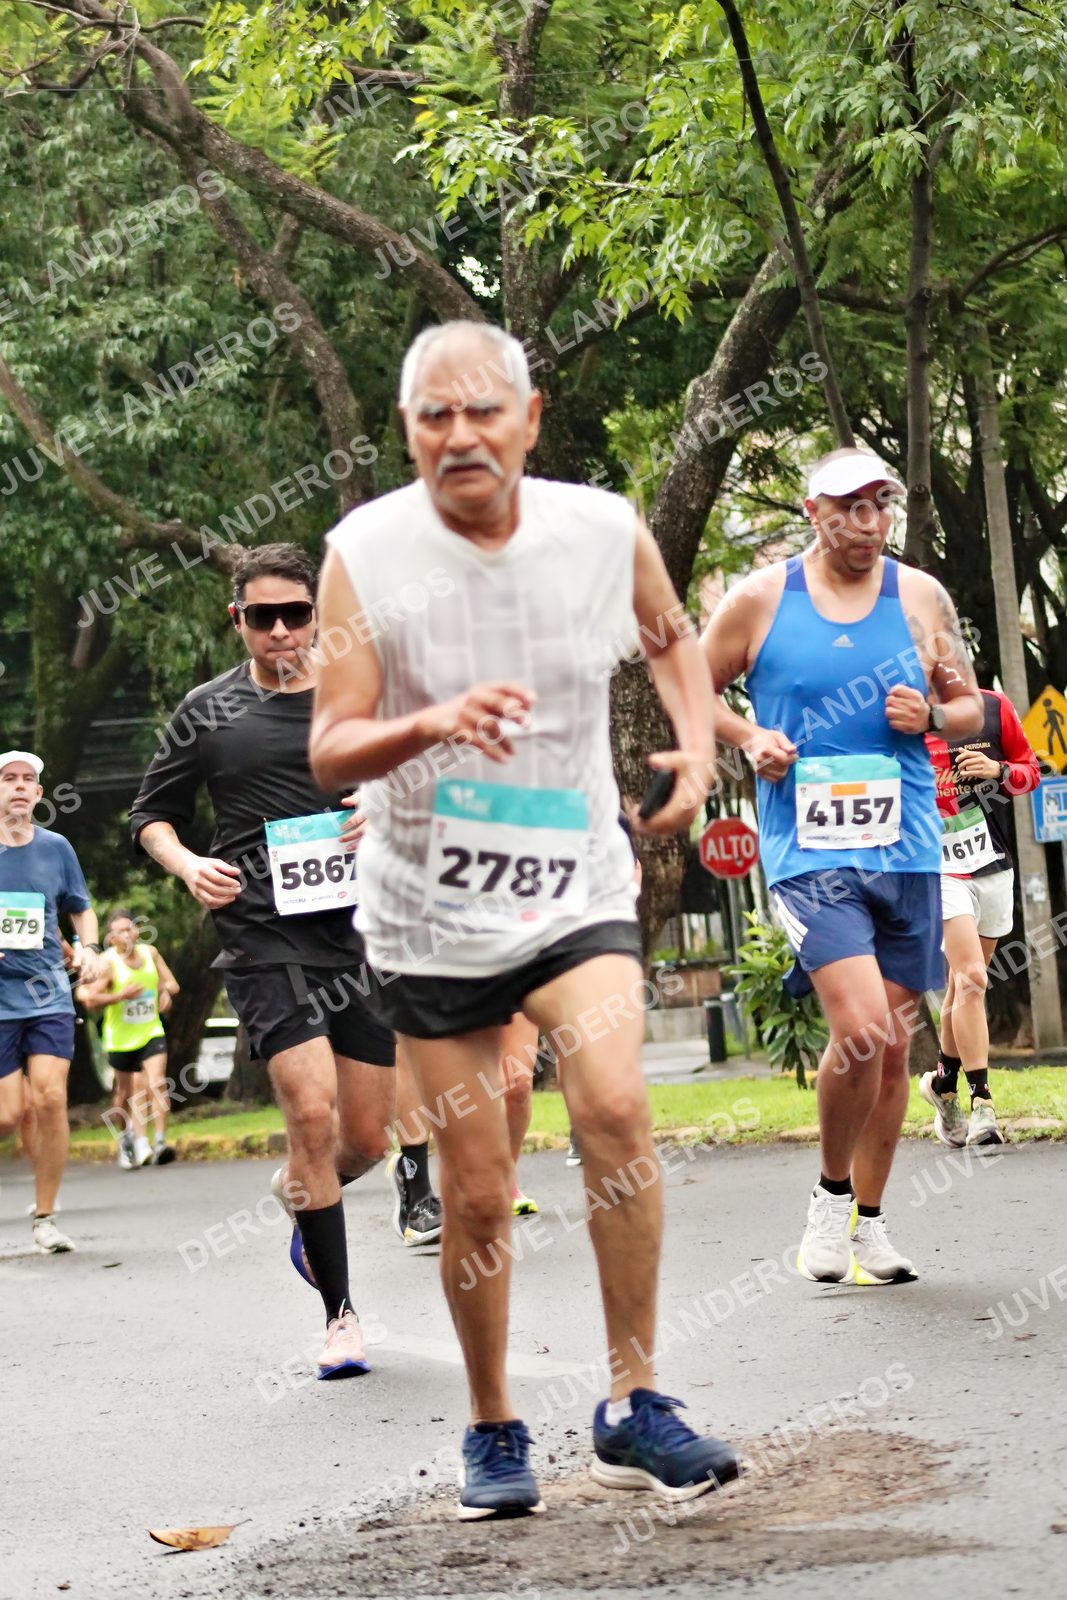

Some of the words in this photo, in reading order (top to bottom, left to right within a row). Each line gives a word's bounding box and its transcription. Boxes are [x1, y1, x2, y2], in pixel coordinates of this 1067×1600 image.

[963, 742, 991, 751] PERDURA
[806, 796, 894, 827] 4157
[706, 834, 755, 861] ALTO
[943, 832, 986, 862] 1617
[280, 852, 356, 890] 5867
[438, 846, 577, 900] 2787
[2, 918, 38, 934] 879
